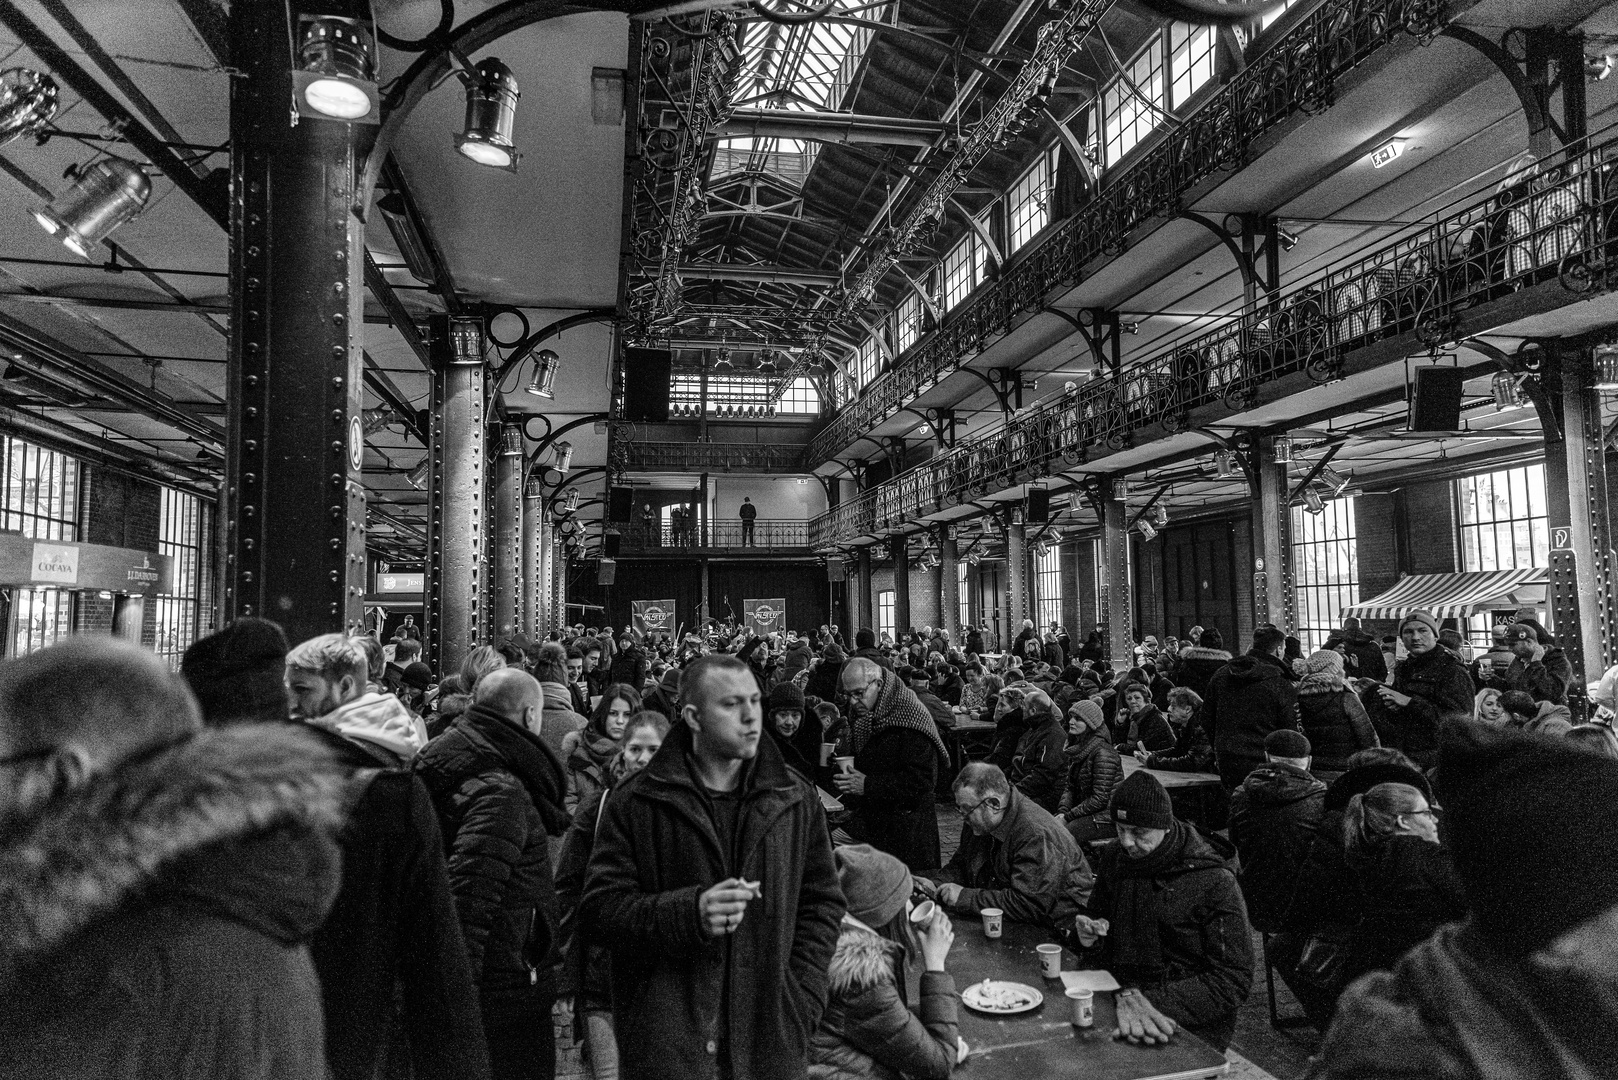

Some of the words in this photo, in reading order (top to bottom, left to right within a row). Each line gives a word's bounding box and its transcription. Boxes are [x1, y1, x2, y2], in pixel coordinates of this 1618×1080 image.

[38, 562, 72, 573] COCAYA
[406, 579, 424, 587] JENS
[1495, 615, 1517, 626] KAS
